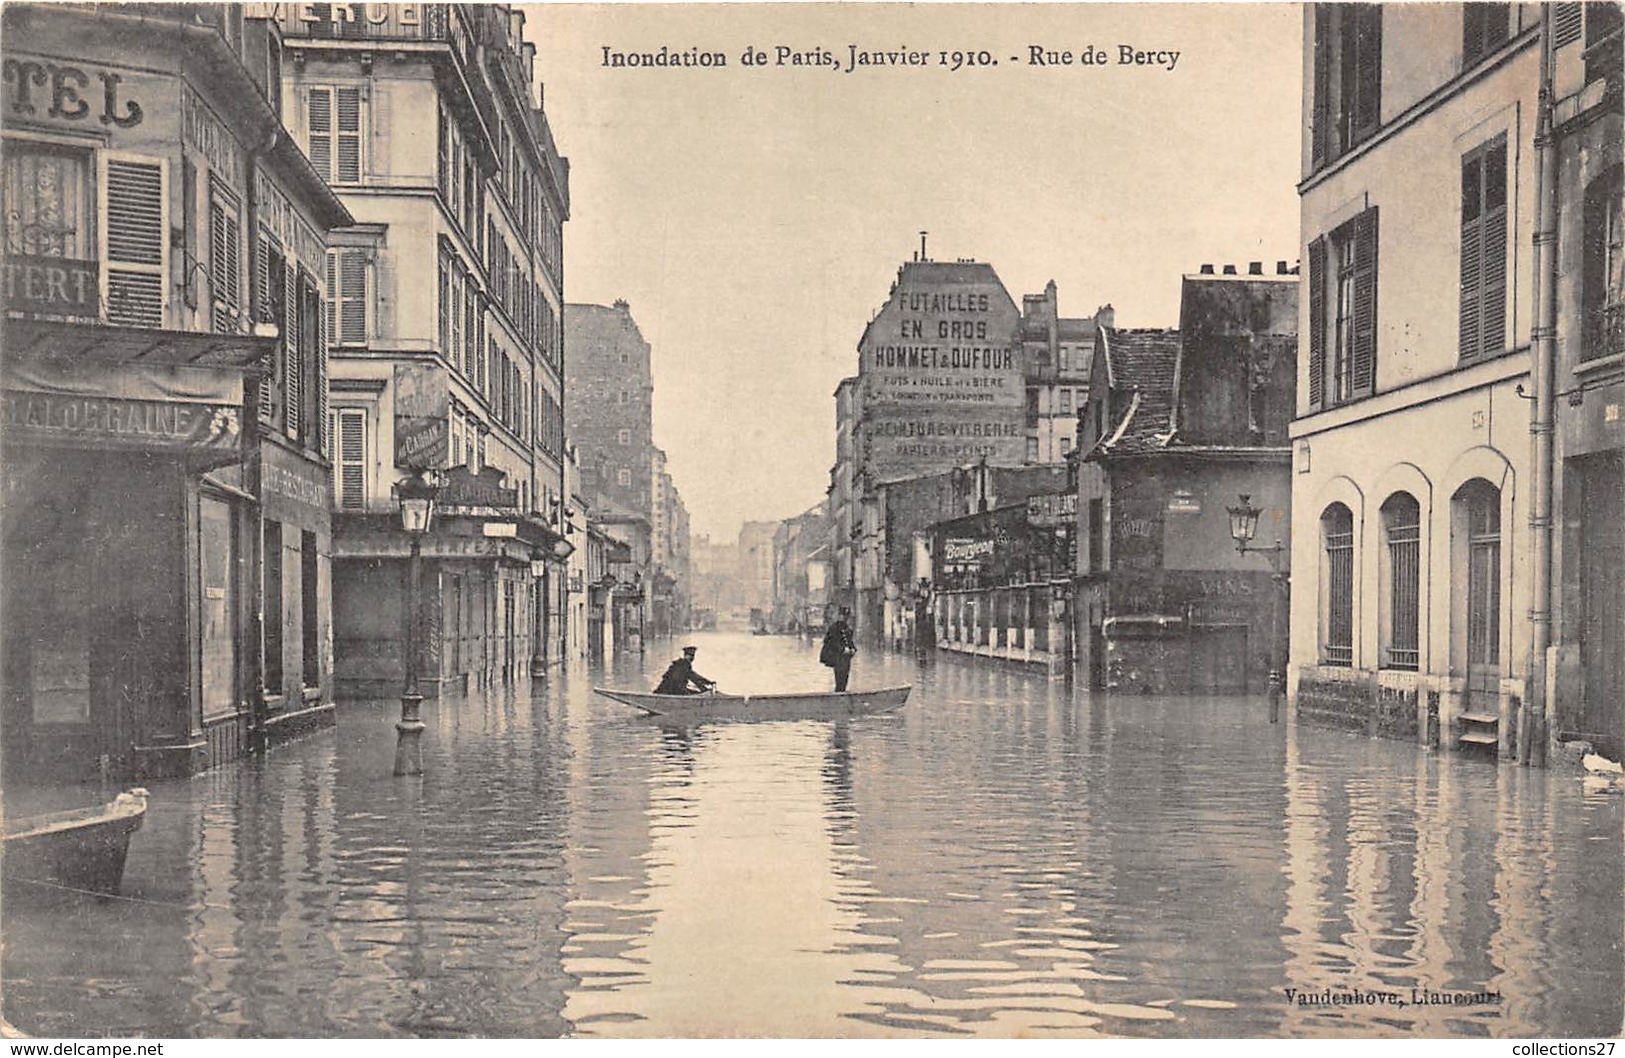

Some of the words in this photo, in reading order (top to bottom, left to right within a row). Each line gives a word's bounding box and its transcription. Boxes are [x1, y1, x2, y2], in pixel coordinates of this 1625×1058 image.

[900, 293, 989, 312] FUTAILLES
[901, 320, 923, 338] EN
[939, 320, 988, 339] GROS
[952, 347, 1012, 369] DUFOUR
